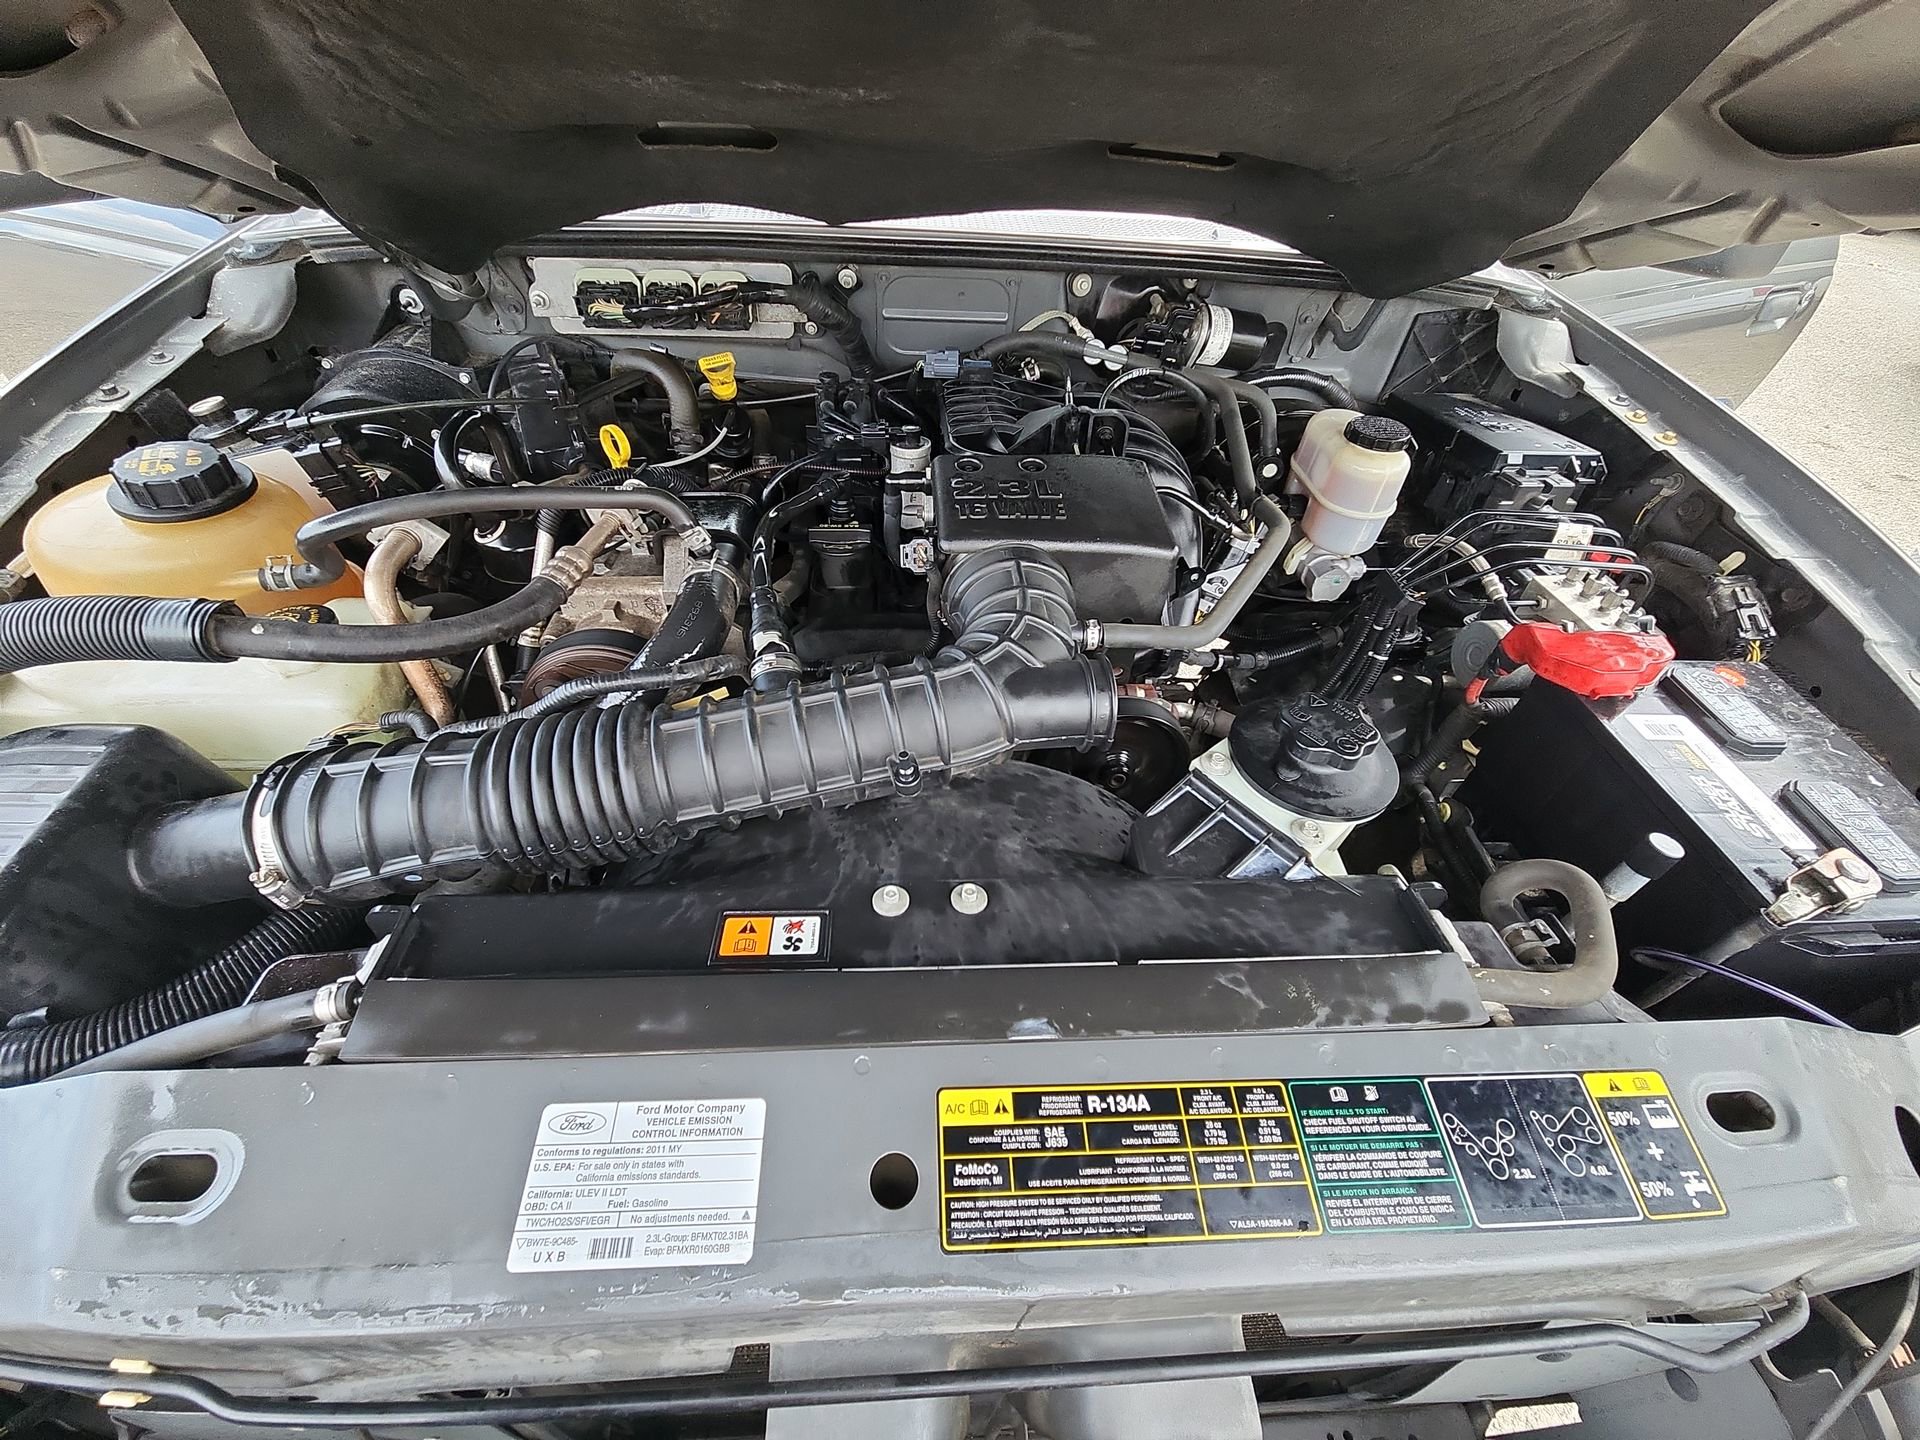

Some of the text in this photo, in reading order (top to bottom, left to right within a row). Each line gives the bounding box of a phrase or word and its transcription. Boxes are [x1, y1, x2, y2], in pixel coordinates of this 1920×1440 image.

[951, 478, 1063, 499] 2.3L
[636, 1103, 746, 1115] Ford Motor Company
[945, 1103, 966, 1115] A/C
[1087, 1093, 1151, 1113] R-134A
[1365, 1107, 1389, 1115] START:
[557, 1113, 597, 1132] Ford
[646, 1116, 732, 1127] VEHICLE EMISSION
[1303, 1115, 1417, 1126] CHECK FUEL SHUTOFF SWITCH AS
[1607, 1111, 1641, 1127] 50%
[632, 1127, 744, 1138] CONTROL INFORMATION
[993, 1128, 1040, 1136] COMPLIES WITH:
[1044, 1126, 1065, 1138] SAE
[1153, 1130, 1179, 1138] CHARGE:
[1217, 1129, 1227, 1138] kg
[1271, 1127, 1281, 1136] kg
[1305, 1123, 1431, 1134] REFERENCED IN YOUR OWNER GUIDE.
[969, 1136, 1001, 1144] CONFORME
[1045, 1137, 1068, 1148] J639
[537, 1147, 579, 1157] Conforms
[592, 1147, 644, 1156] regulations:
[645, 1145, 666, 1154] 2011
[668, 1144, 682, 1153] MY
[1357, 1152, 1396, 1160] COMMANDE
[1397, 1151, 1408, 1159] DE
[1408, 1150, 1443, 1159] COUPURE
[533, 1160, 684, 1172] U.S. EPA: For sale only in states with
[955, 1163, 999, 1175] FoMoCo
[1315, 1163, 1326, 1171] DE
[1326, 1161, 1373, 1170] CARBURANT,
[1372, 1161, 1399, 1169] COMME
[1590, 1165, 1613, 1177] 4.0L
[575, 1171, 701, 1183] California emissions standards.
[1317, 1171, 1339, 1180] DANS
[1339, 1171, 1349, 1179] LE
[1349, 1170, 1374, 1179] GUIDE
[1375, 1170, 1385, 1178] DE
[1512, 1168, 1536, 1180] 2.3L
[953, 1175, 1003, 1187] Dearborn, MI
[527, 1187, 628, 1200] California: ULEV II LDT
[1381, 1187, 1417, 1195] ARRANCA:
[1640, 1182, 1674, 1198] 50%
[524, 1201, 572, 1211] OBD: CA II
[607, 1198, 669, 1209] Fuel: Gasoline
[1325, 1195, 1453, 1208] REVISE EL INTERRUPTOR DE CIERRE
[1328, 1204, 1455, 1217] DEL COMBUSTIBLE COMO SE INDICA
[525, 1215, 610, 1227] TWC/HO2S/SFI/EGR
[630, 1212, 731, 1224] No adjustments needed.
[1331, 1219, 1341, 1227] EN
[1342, 1218, 1354, 1226] LA
[1372, 1217, 1387, 1225] DEL
[1386, 1215, 1439, 1225] PROPIETARIO.
[646, 1233, 689, 1243] 2.3L-Group:
[533, 1251, 566, 1263] U X B
[644, 1247, 665, 1257] Evap:
